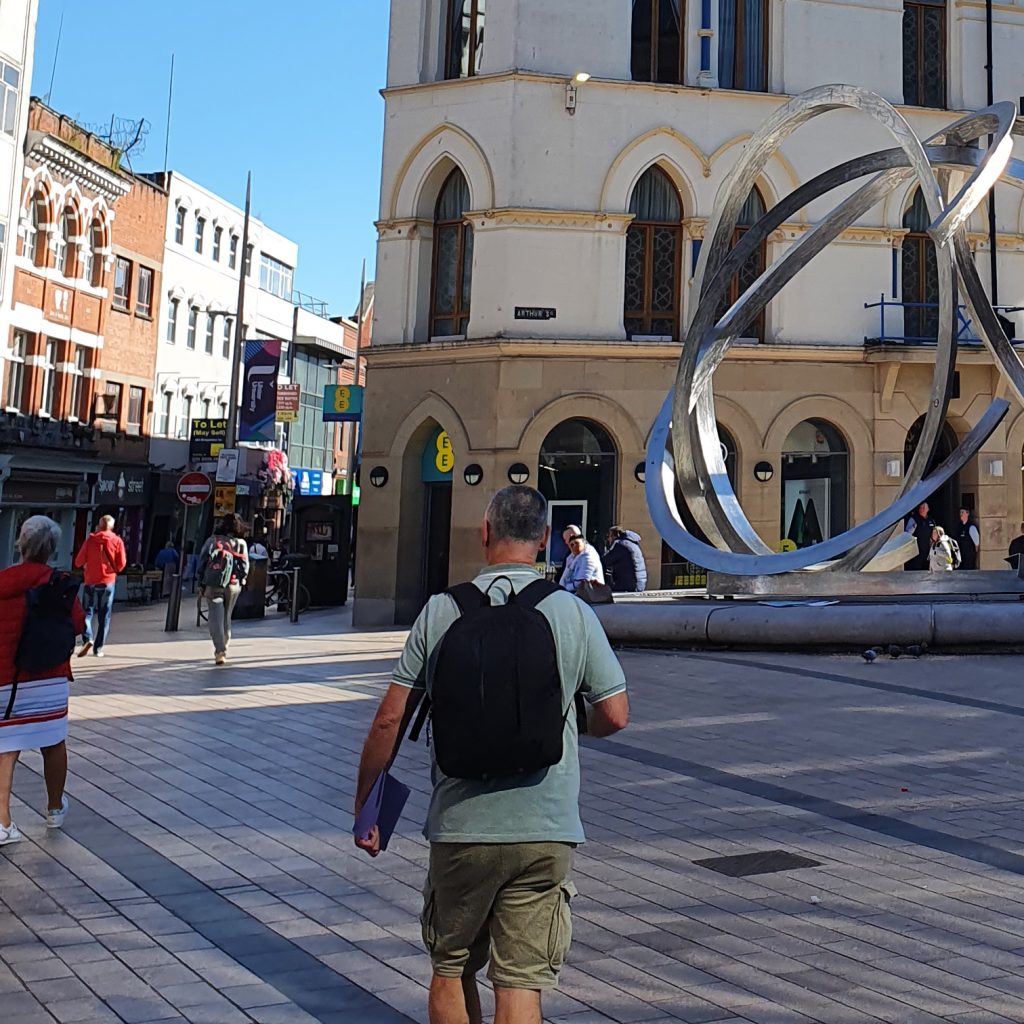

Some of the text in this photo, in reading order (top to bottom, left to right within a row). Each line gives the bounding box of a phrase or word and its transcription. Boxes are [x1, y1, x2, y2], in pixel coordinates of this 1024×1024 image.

[517, 309, 543, 317] ARTHUR
[193, 420, 227, 429] To Let
